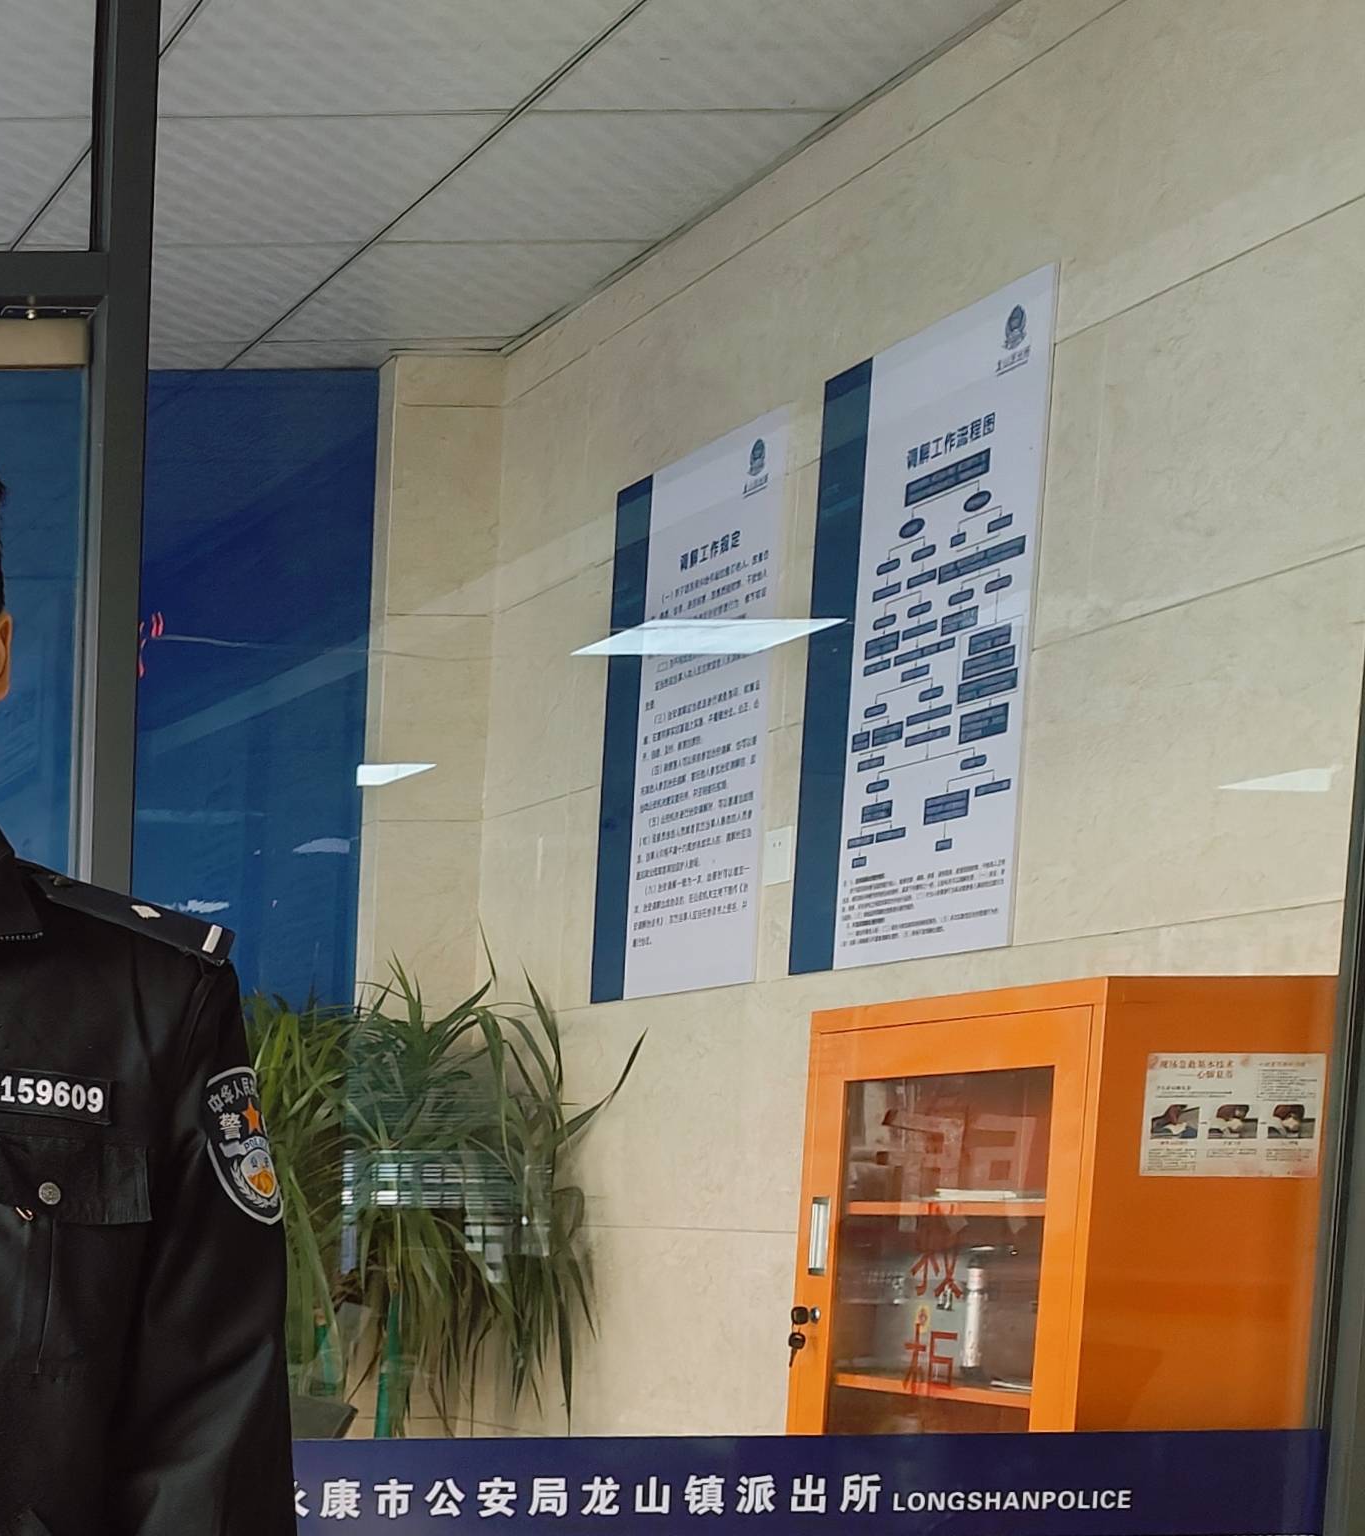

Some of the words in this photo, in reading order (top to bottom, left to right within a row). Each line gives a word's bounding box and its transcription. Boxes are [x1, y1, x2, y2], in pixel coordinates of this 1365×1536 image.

[907, 412, 996, 469] 调解工作流程图
[680, 530, 740, 571] 调解工作规定
[0, 1075, 106, 1114] 159609
[220, 1112, 242, 1140] 警
[892, 1488, 1132, 1512] LONGSHANPOLICE
